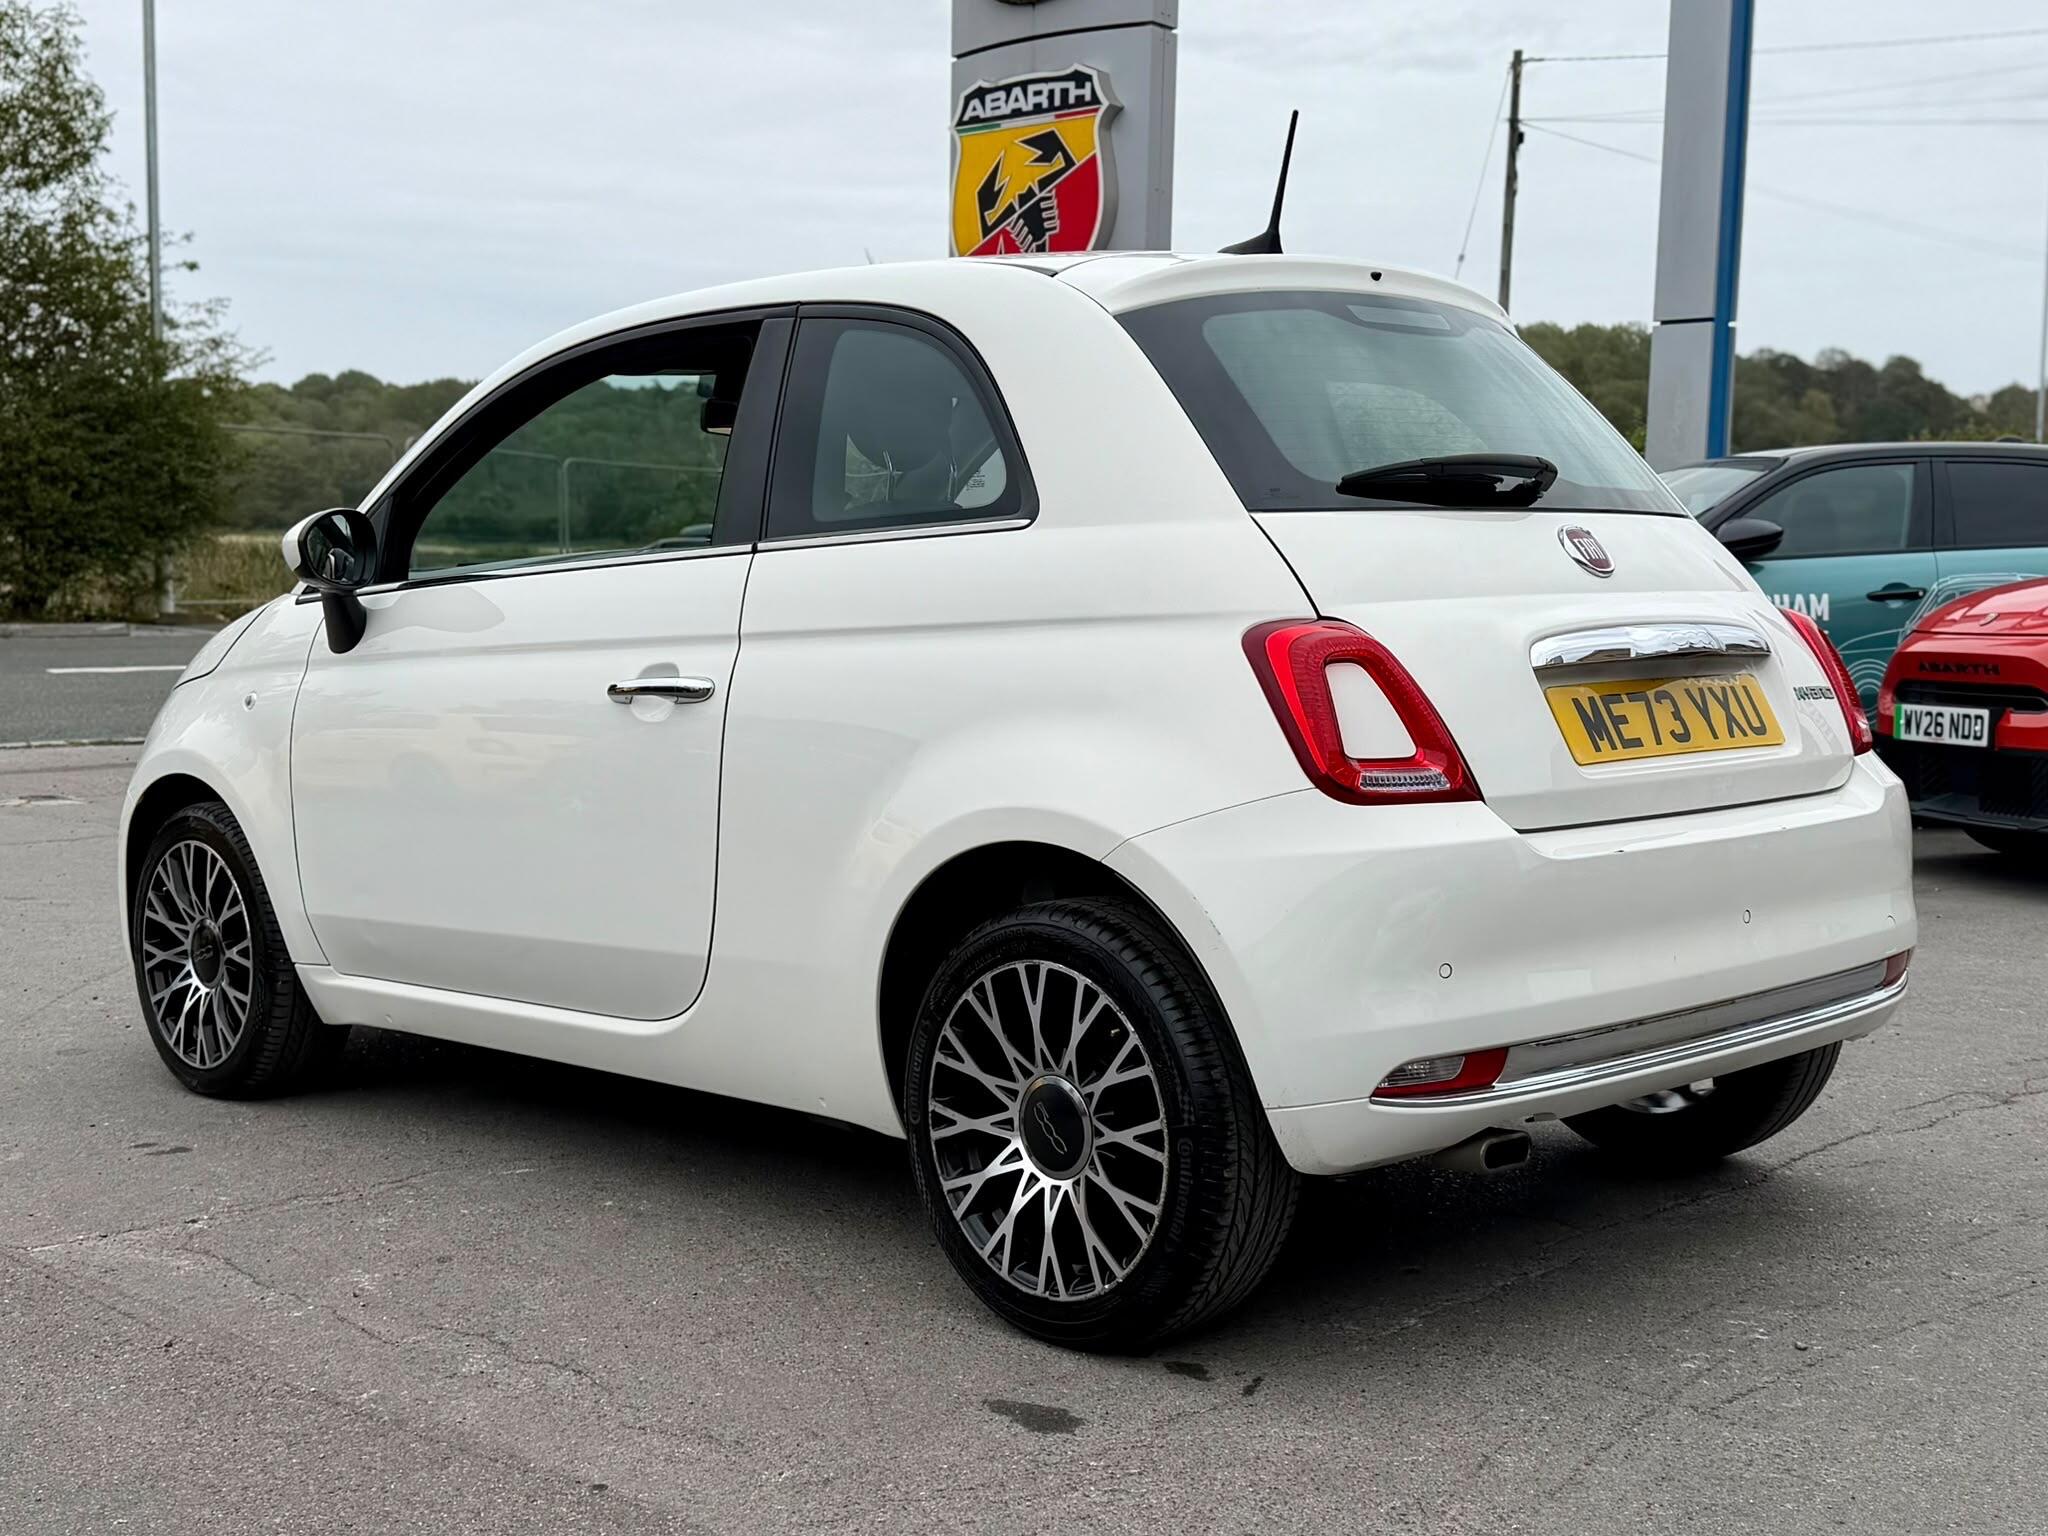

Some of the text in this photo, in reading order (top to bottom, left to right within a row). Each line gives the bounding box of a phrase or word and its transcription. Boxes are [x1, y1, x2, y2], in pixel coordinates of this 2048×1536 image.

[962, 81, 1092, 122] ABARTH
[1572, 537, 1607, 561] FIAT
[1919, 661, 2001, 675] ABARTH
[1571, 685, 1768, 753] ME73 YXU
[1904, 709, 1945, 738] WV26
